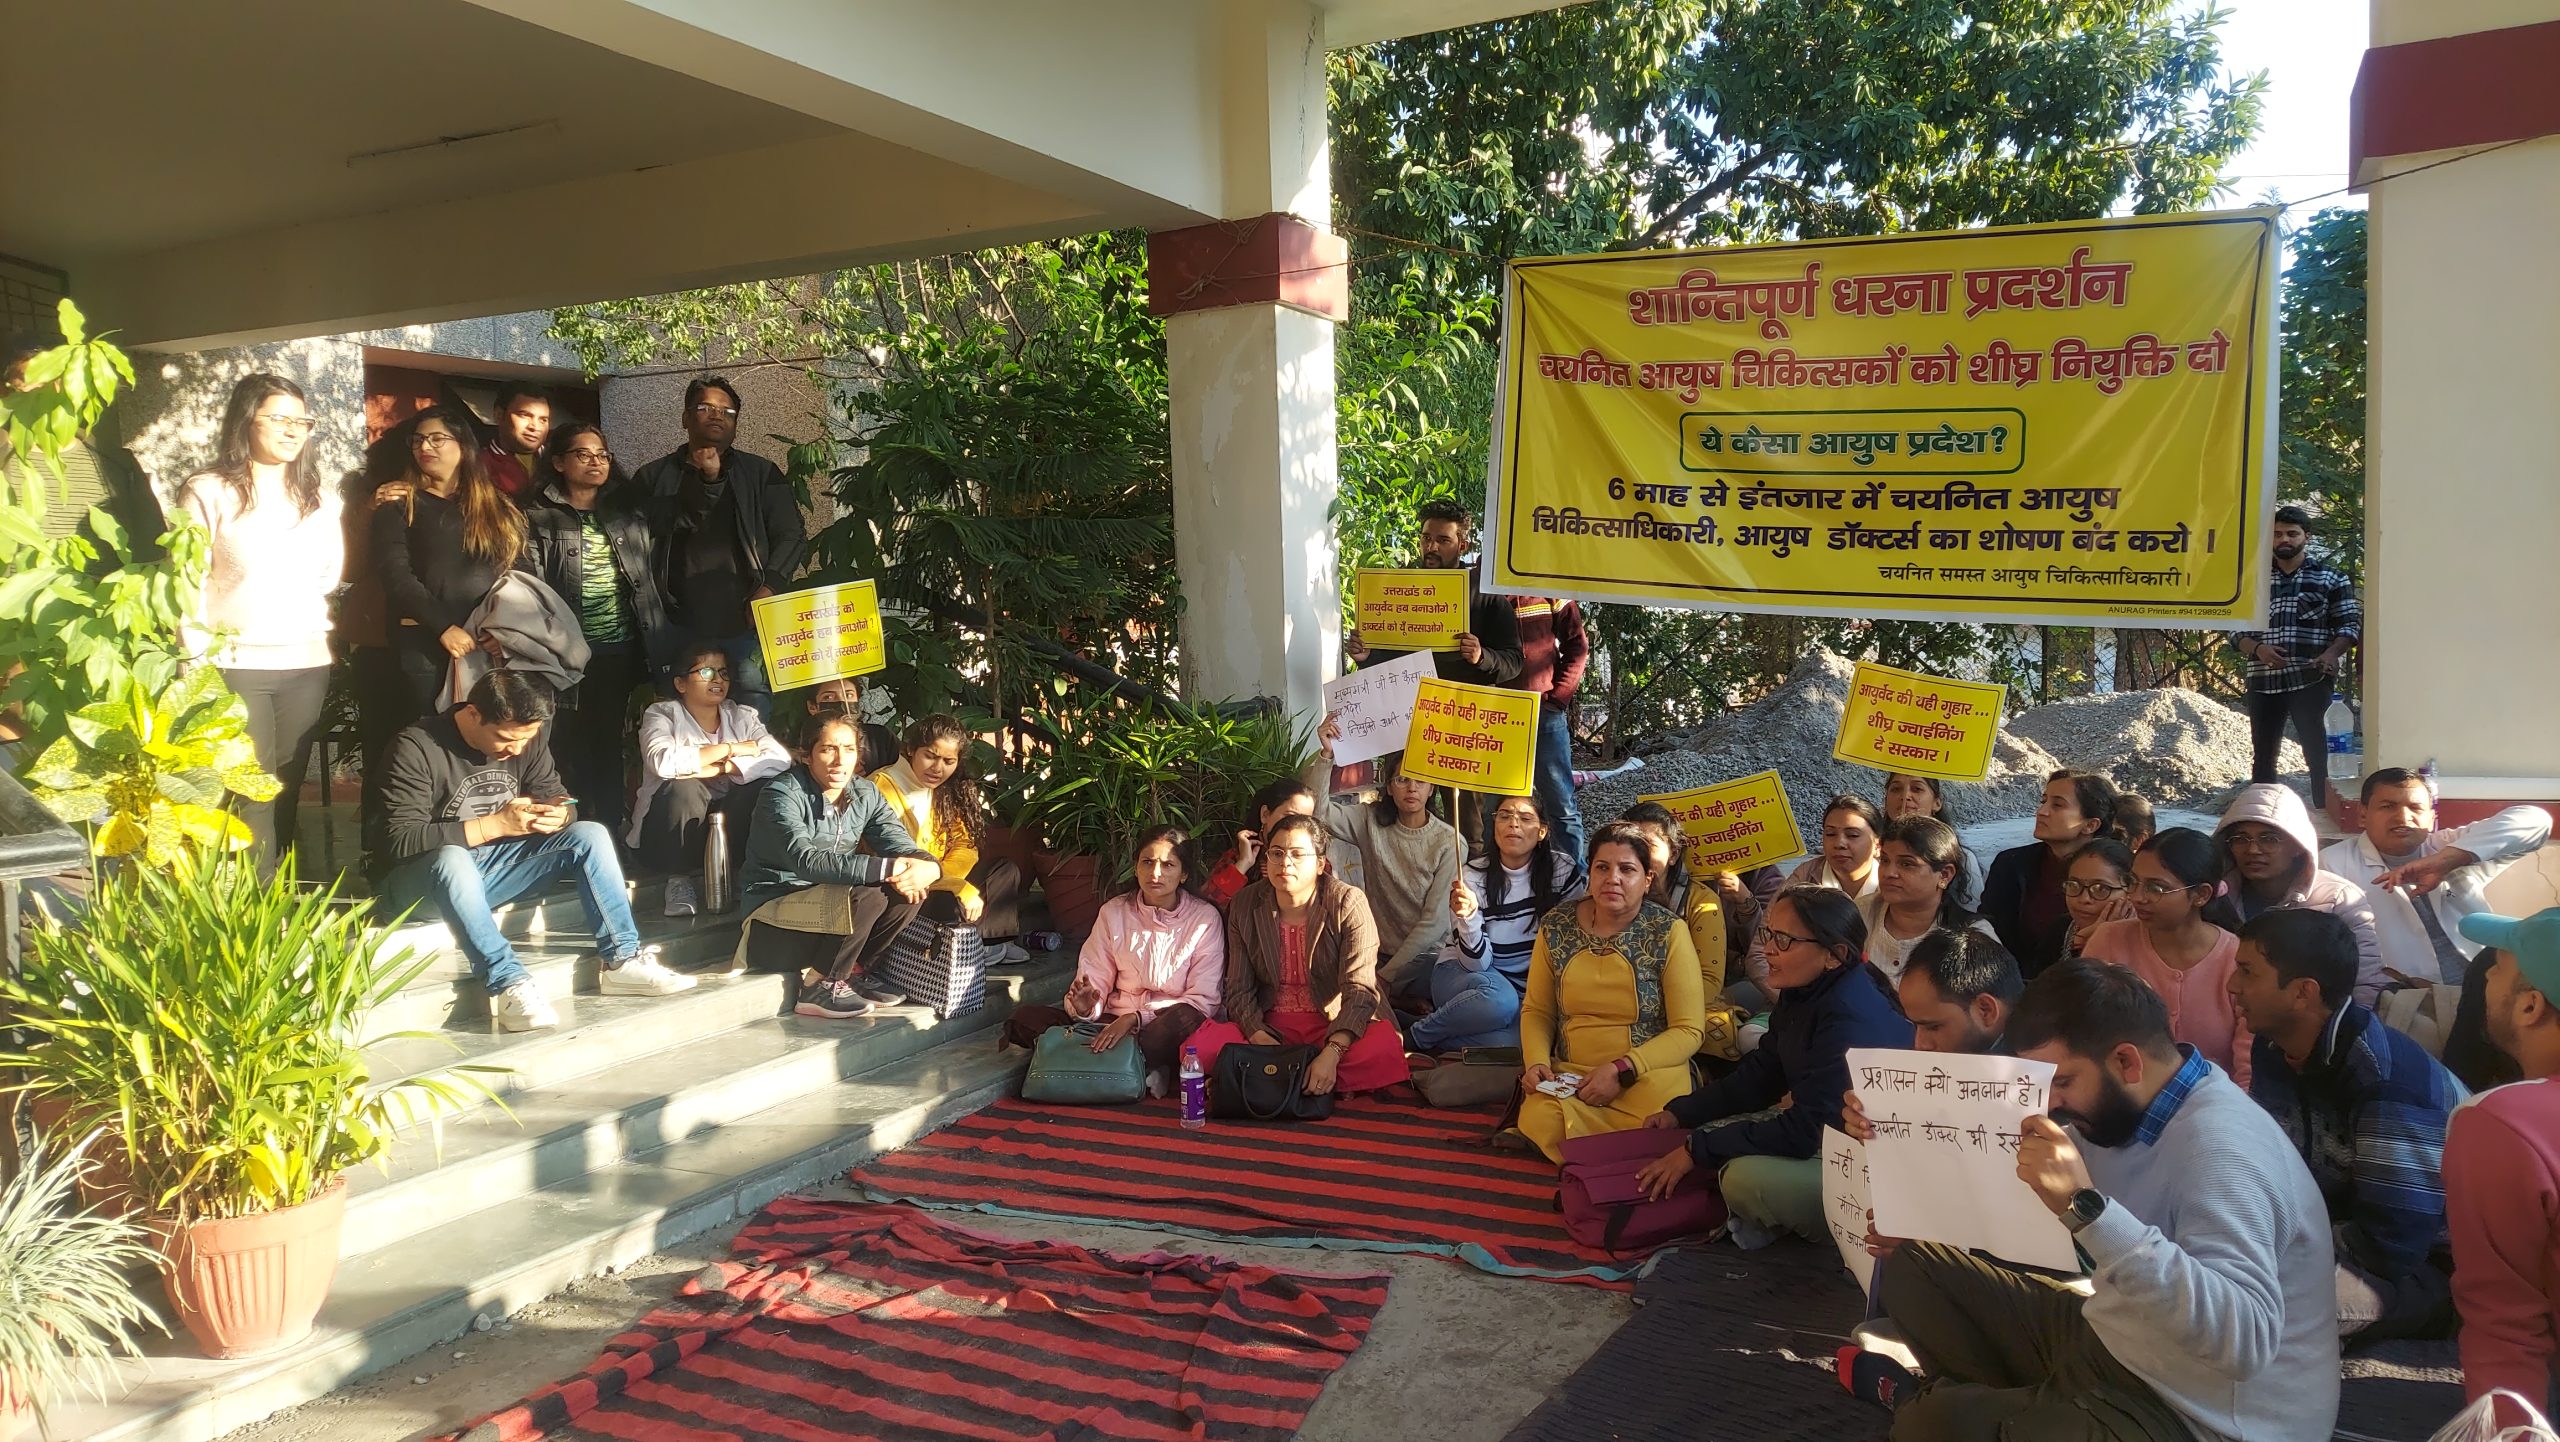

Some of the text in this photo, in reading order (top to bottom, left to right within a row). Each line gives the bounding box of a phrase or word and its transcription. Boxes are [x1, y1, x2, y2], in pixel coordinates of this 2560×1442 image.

[1628, 246, 2134, 342] शान्तिपूर्ण धरना प्रदर्शन
[1539, 328, 2232, 405] चयनित आयुष चिकित्सकों को शीघ्र नियुक्ति दो
[1699, 423, 2008, 467] ये कैसा आयुष प्रदेश?
[1608, 477, 2122, 523] 6 माह से इंतजार में चयनित आयुष
[1532, 505, 1724, 547] चिकित्साधिकारी,
[1734, 525, 1812, 559] आयुष
[1827, 520, 1922, 552] डॉक्टर्स
[1929, 529, 1971, 551] का
[1979, 521, 2065, 552] शोषण
[2072, 521, 2120, 553] बंद
[2127, 521, 2191, 553] करो
[1878, 562, 1935, 582] चयनित
[1938, 567, 1987, 584] समस्त
[1991, 568, 2041, 589] आयुष
[1383, 585, 1436, 597] उत्तराखंड को
[796, 601, 855, 622] उत्तराखंड को
[1364, 601, 1393, 616] आयुर्वेद
[2108, 606, 2146, 615] ANURAG
[2147, 607, 2177, 615] Printers
[775, 627, 814, 647] आयुर्वेद
[1362, 620, 1385, 632] डाक्टर्स
[1387, 621, 1397, 632] को
[777, 650, 809, 669] डाक्टर्स
[811, 648, 824, 662] को
[1418, 696, 1441, 719] आयुर्वेद
[1443, 699, 1456, 717] की
[1458, 702, 1477, 721] यही
[1480, 708, 1509, 729] गुहार
[1859, 683, 1895, 706] आयुर्वेद
[1897, 688, 1913, 707] की
[1916, 693, 1938, 712] यही
[1941, 700, 1974, 720] गुहार
[1423, 724, 1505, 753] शीघ्र ज्वाईनिंग
[1867, 711, 1966, 742] शीघ्र ज्वाईनिंग
[1427, 749, 1436, 766] दे
[1438, 754, 1481, 774] सरकार
[1873, 735, 1886, 752] दे
[1888, 741, 1940, 762] सरकार
[1689, 804, 1704, 821] की
[1706, 800, 1727, 818] यही
[1729, 796, 1758, 819] गुहार
[1704, 820, 1765, 846] ज्वाईनिंग
[1691, 853, 1703, 867] दे
[1705, 845, 1751, 867] सरकार
[1860, 1066, 1918, 1094] प्रशासन
[1924, 1066, 1952, 1096] क्यों
[1956, 1079, 2010, 1102] अनजान
[1869, 1112, 1912, 1140] चयनीत
[1921, 1121, 1964, 1153] डॉक्टर
[1966, 1123, 1988, 1154] भी
